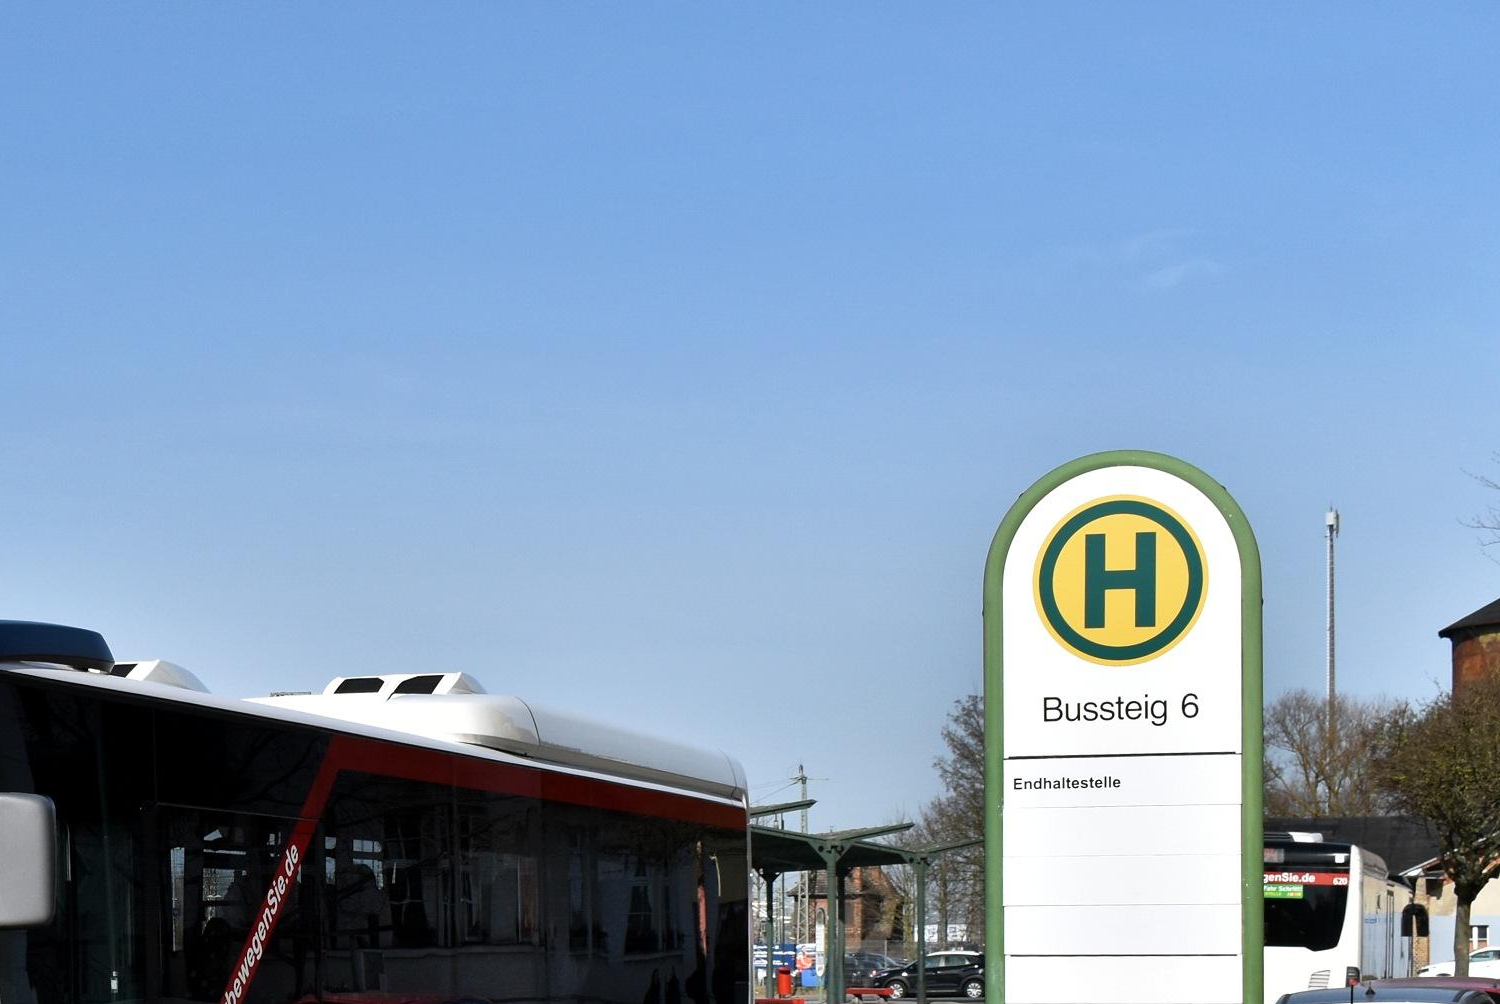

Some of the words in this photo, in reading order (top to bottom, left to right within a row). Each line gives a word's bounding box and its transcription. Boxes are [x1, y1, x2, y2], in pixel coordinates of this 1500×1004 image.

[1084, 532, 1157, 629] H
[1043, 694, 1168, 726] Bussteig
[1181, 692, 1199, 719] 6
[1013, 776, 1121, 790] Endhaltestelle
[1263, 872, 1316, 884] genSie.de
